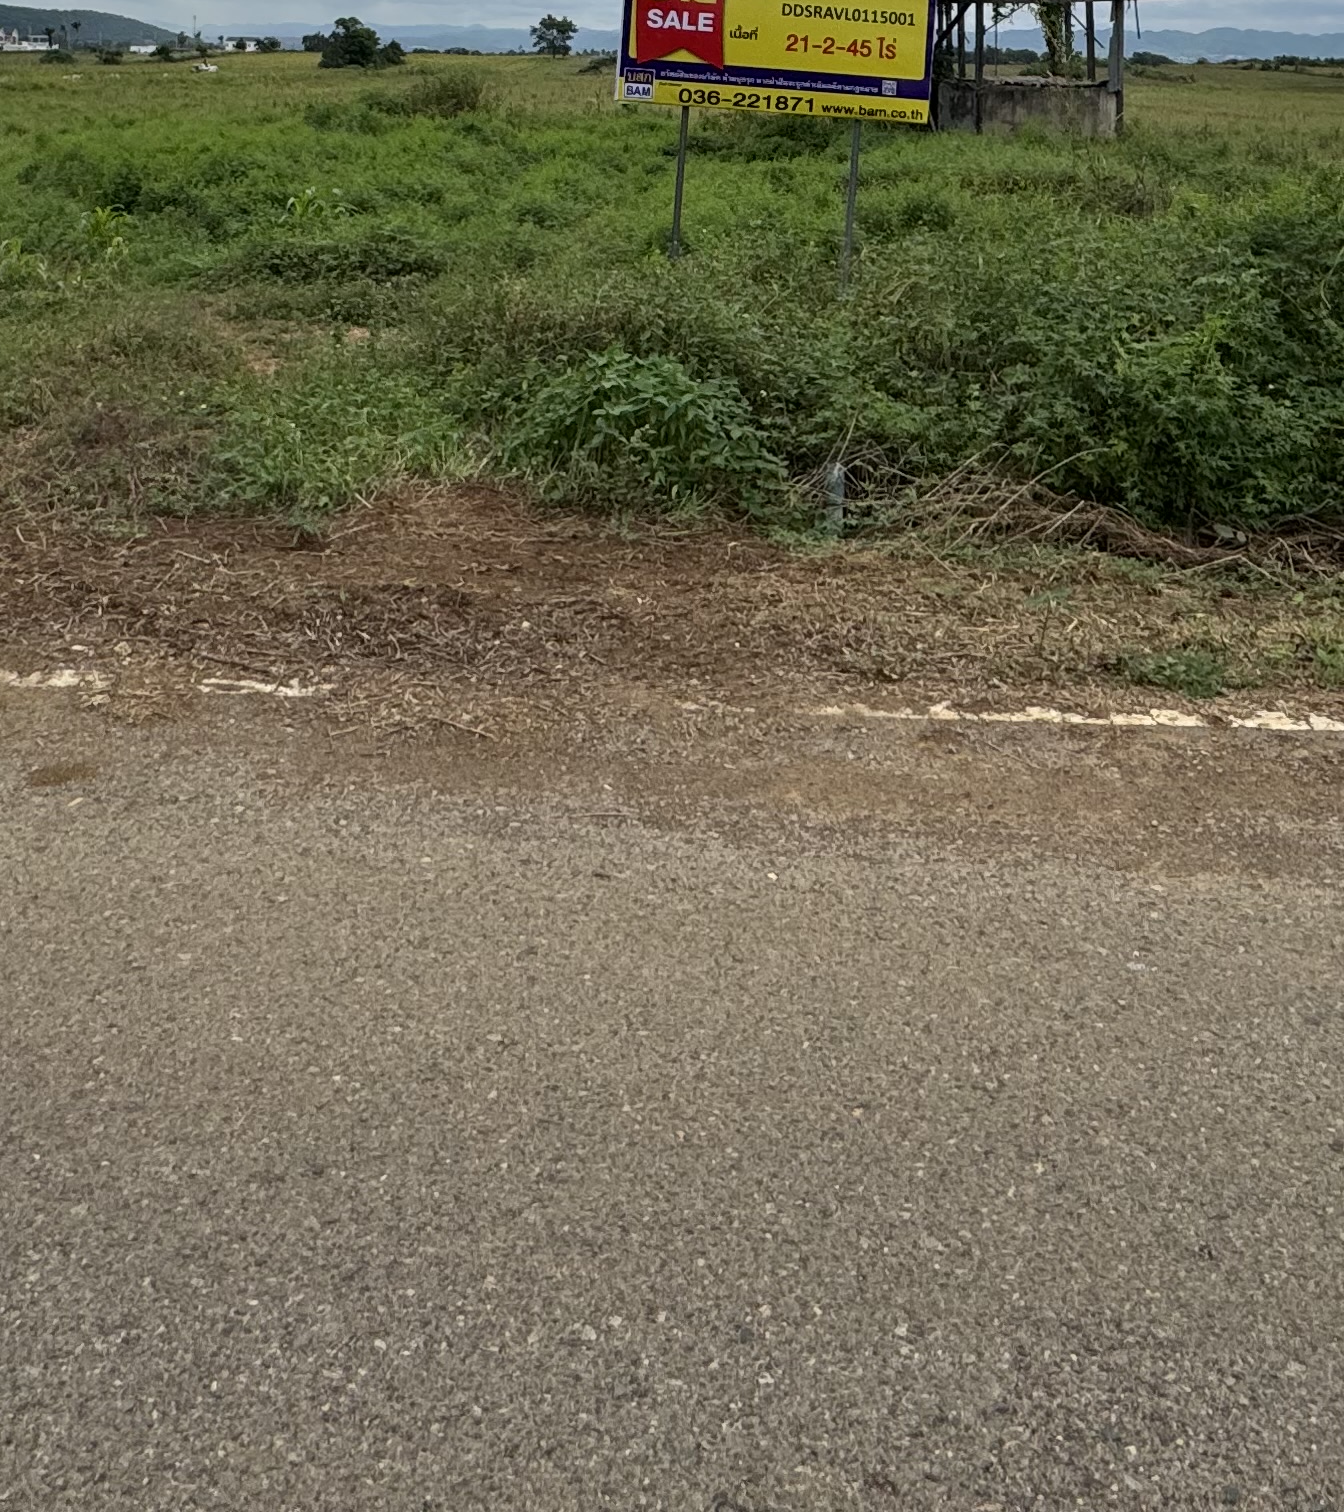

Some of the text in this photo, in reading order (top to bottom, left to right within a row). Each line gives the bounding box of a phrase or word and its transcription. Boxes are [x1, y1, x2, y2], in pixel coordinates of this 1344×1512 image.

[646, 8, 715, 33] SALE
[781, 2, 916, 27] DDSRAVL0115001
[729, 24, 897, 60] เนื้อที่ 21-2-45 ไร่
[626, 85, 651, 97] BAM
[678, 88, 923, 120] 036-221871 www.bam.co.th
